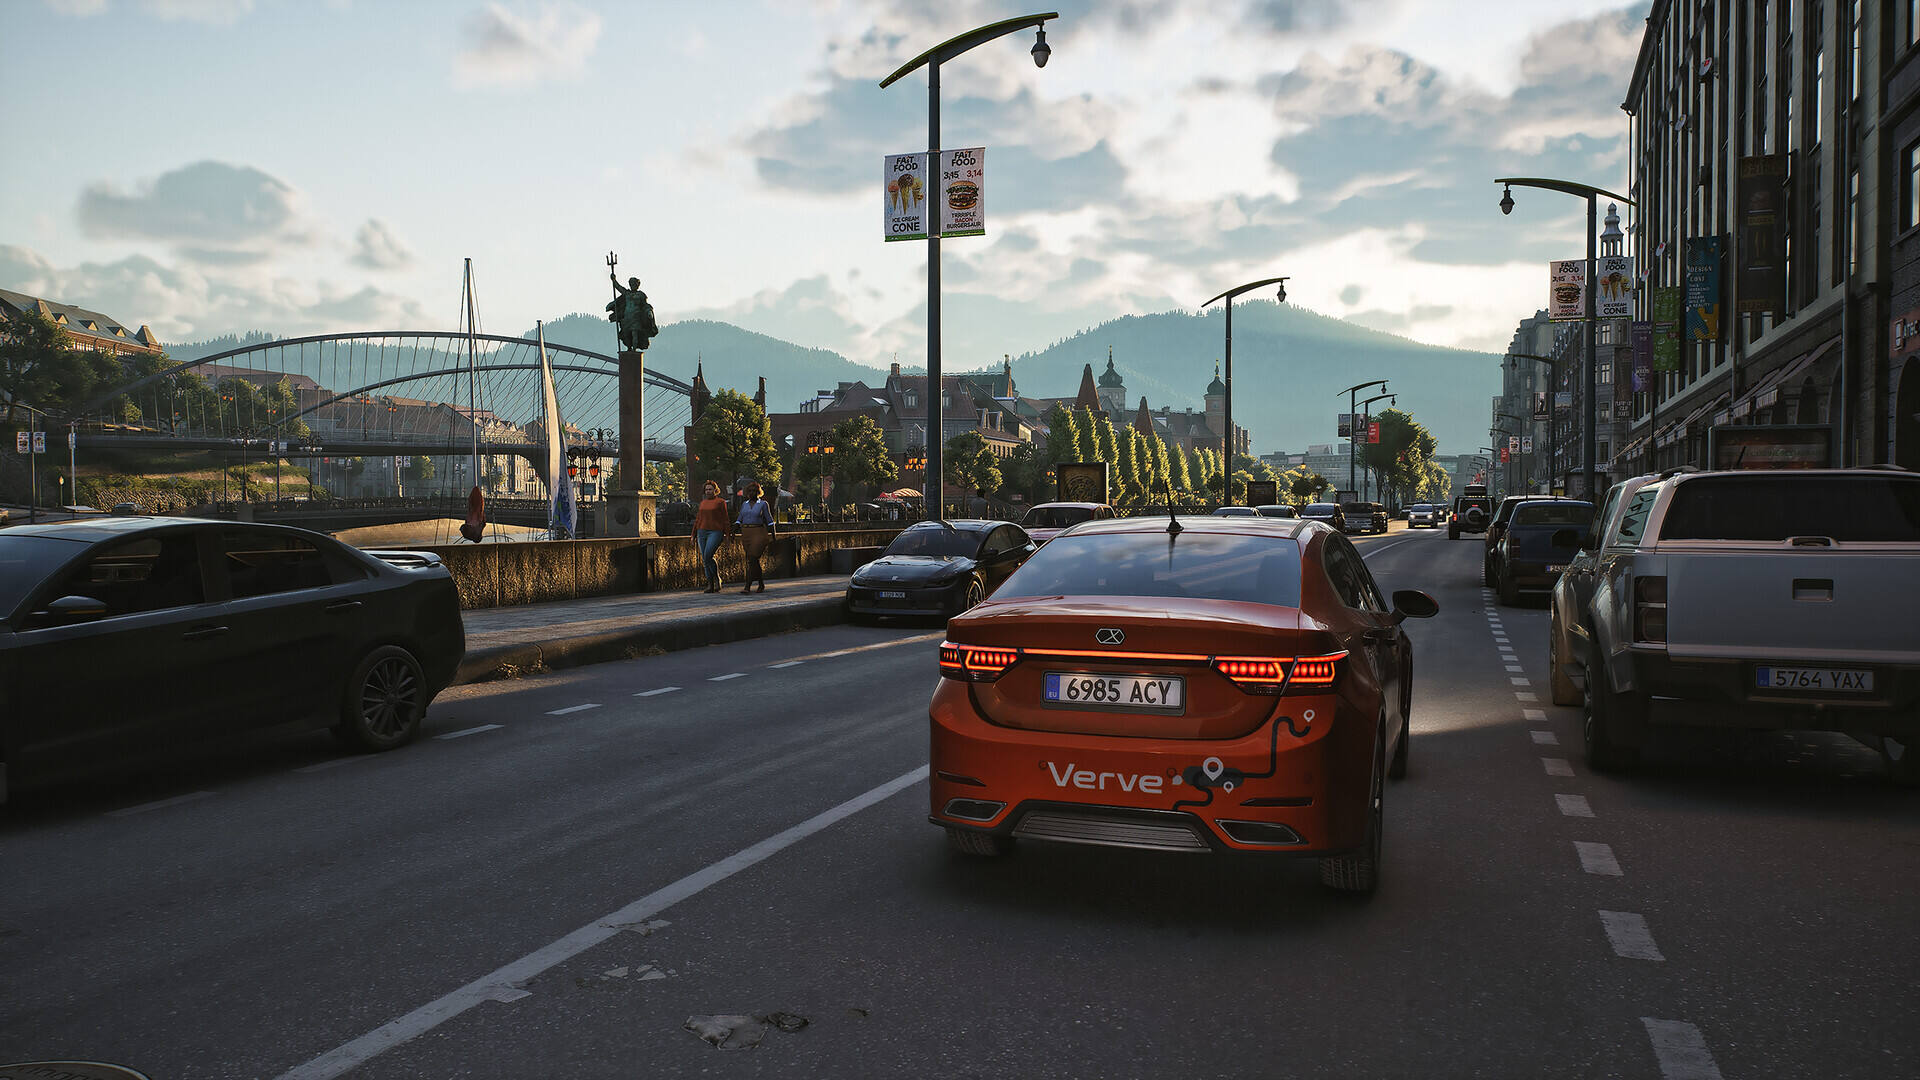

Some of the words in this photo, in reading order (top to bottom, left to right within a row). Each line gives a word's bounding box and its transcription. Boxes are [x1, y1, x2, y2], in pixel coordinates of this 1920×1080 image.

[894, 163, 918, 172] FOOD
[952, 158, 976, 166] FOOD
[944, 170, 960, 179] 3,15
[966, 169, 983, 178] 3,14
[892, 222, 920, 233] CONE
[1775, 670, 1822, 688] 5764
[1831, 671, 1865, 689] YAX
[1066, 678, 1121, 702] 6985
[1130, 681, 1171, 704] ACY
[1047, 762, 1163, 794] Verve
